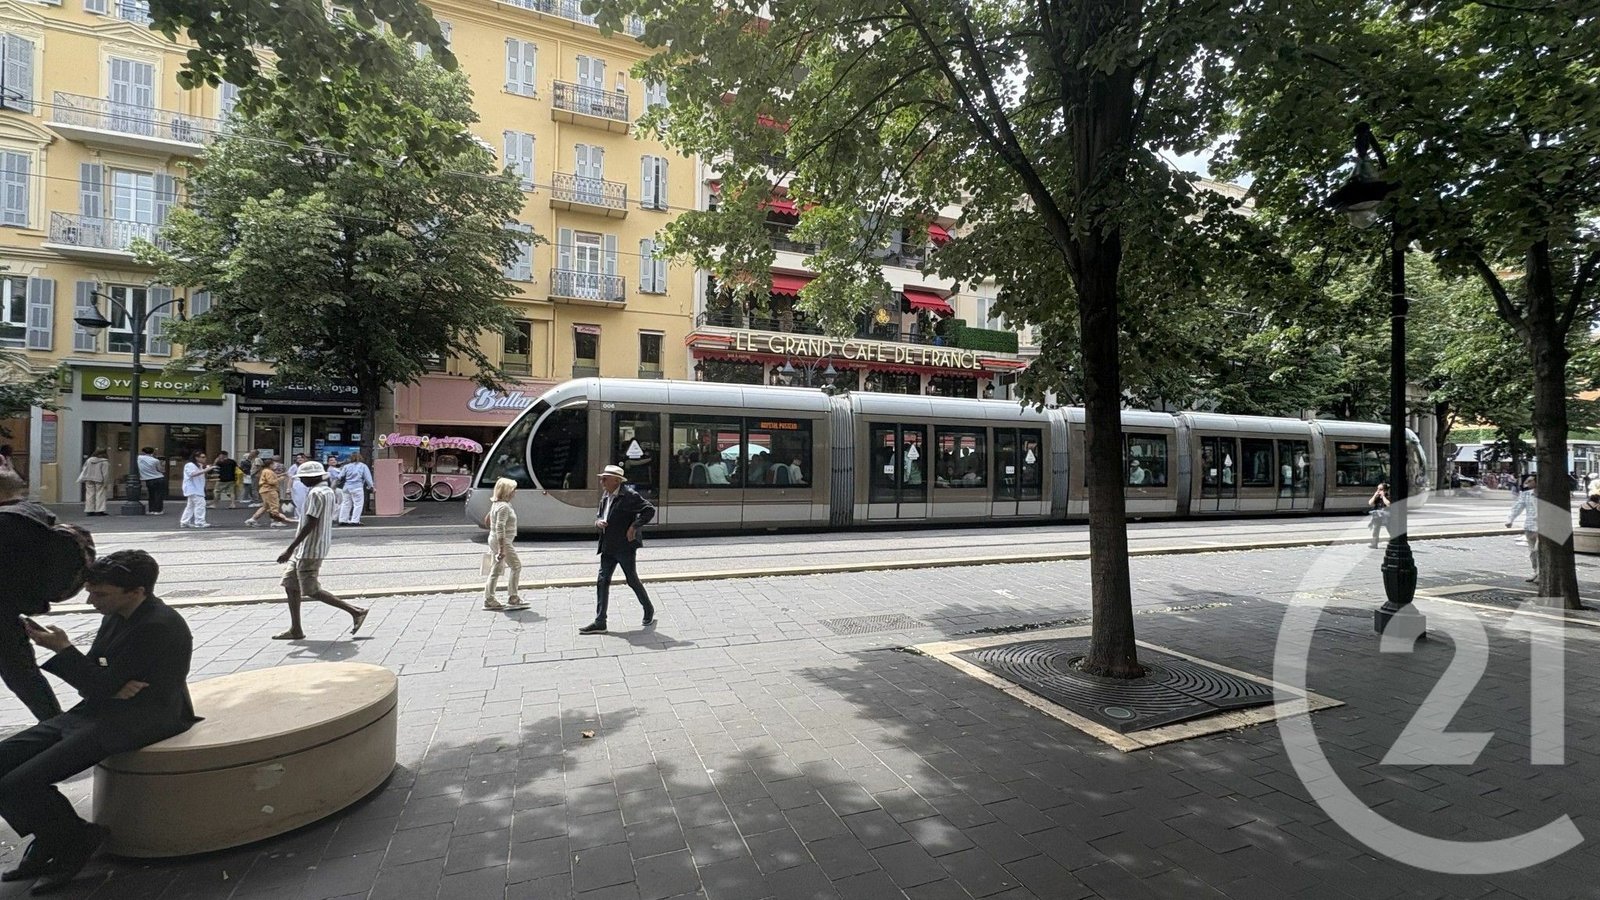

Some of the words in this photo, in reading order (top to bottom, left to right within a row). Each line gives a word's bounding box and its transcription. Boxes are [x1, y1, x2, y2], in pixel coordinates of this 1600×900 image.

[735, 332, 758, 352] LE
[768, 335, 833, 357] GRAND
[895, 347, 914, 364] DE
[922, 350, 982, 370] FRANCE
[113, 379, 149, 388] YVS
[154, 381, 210, 391] ROCHR
